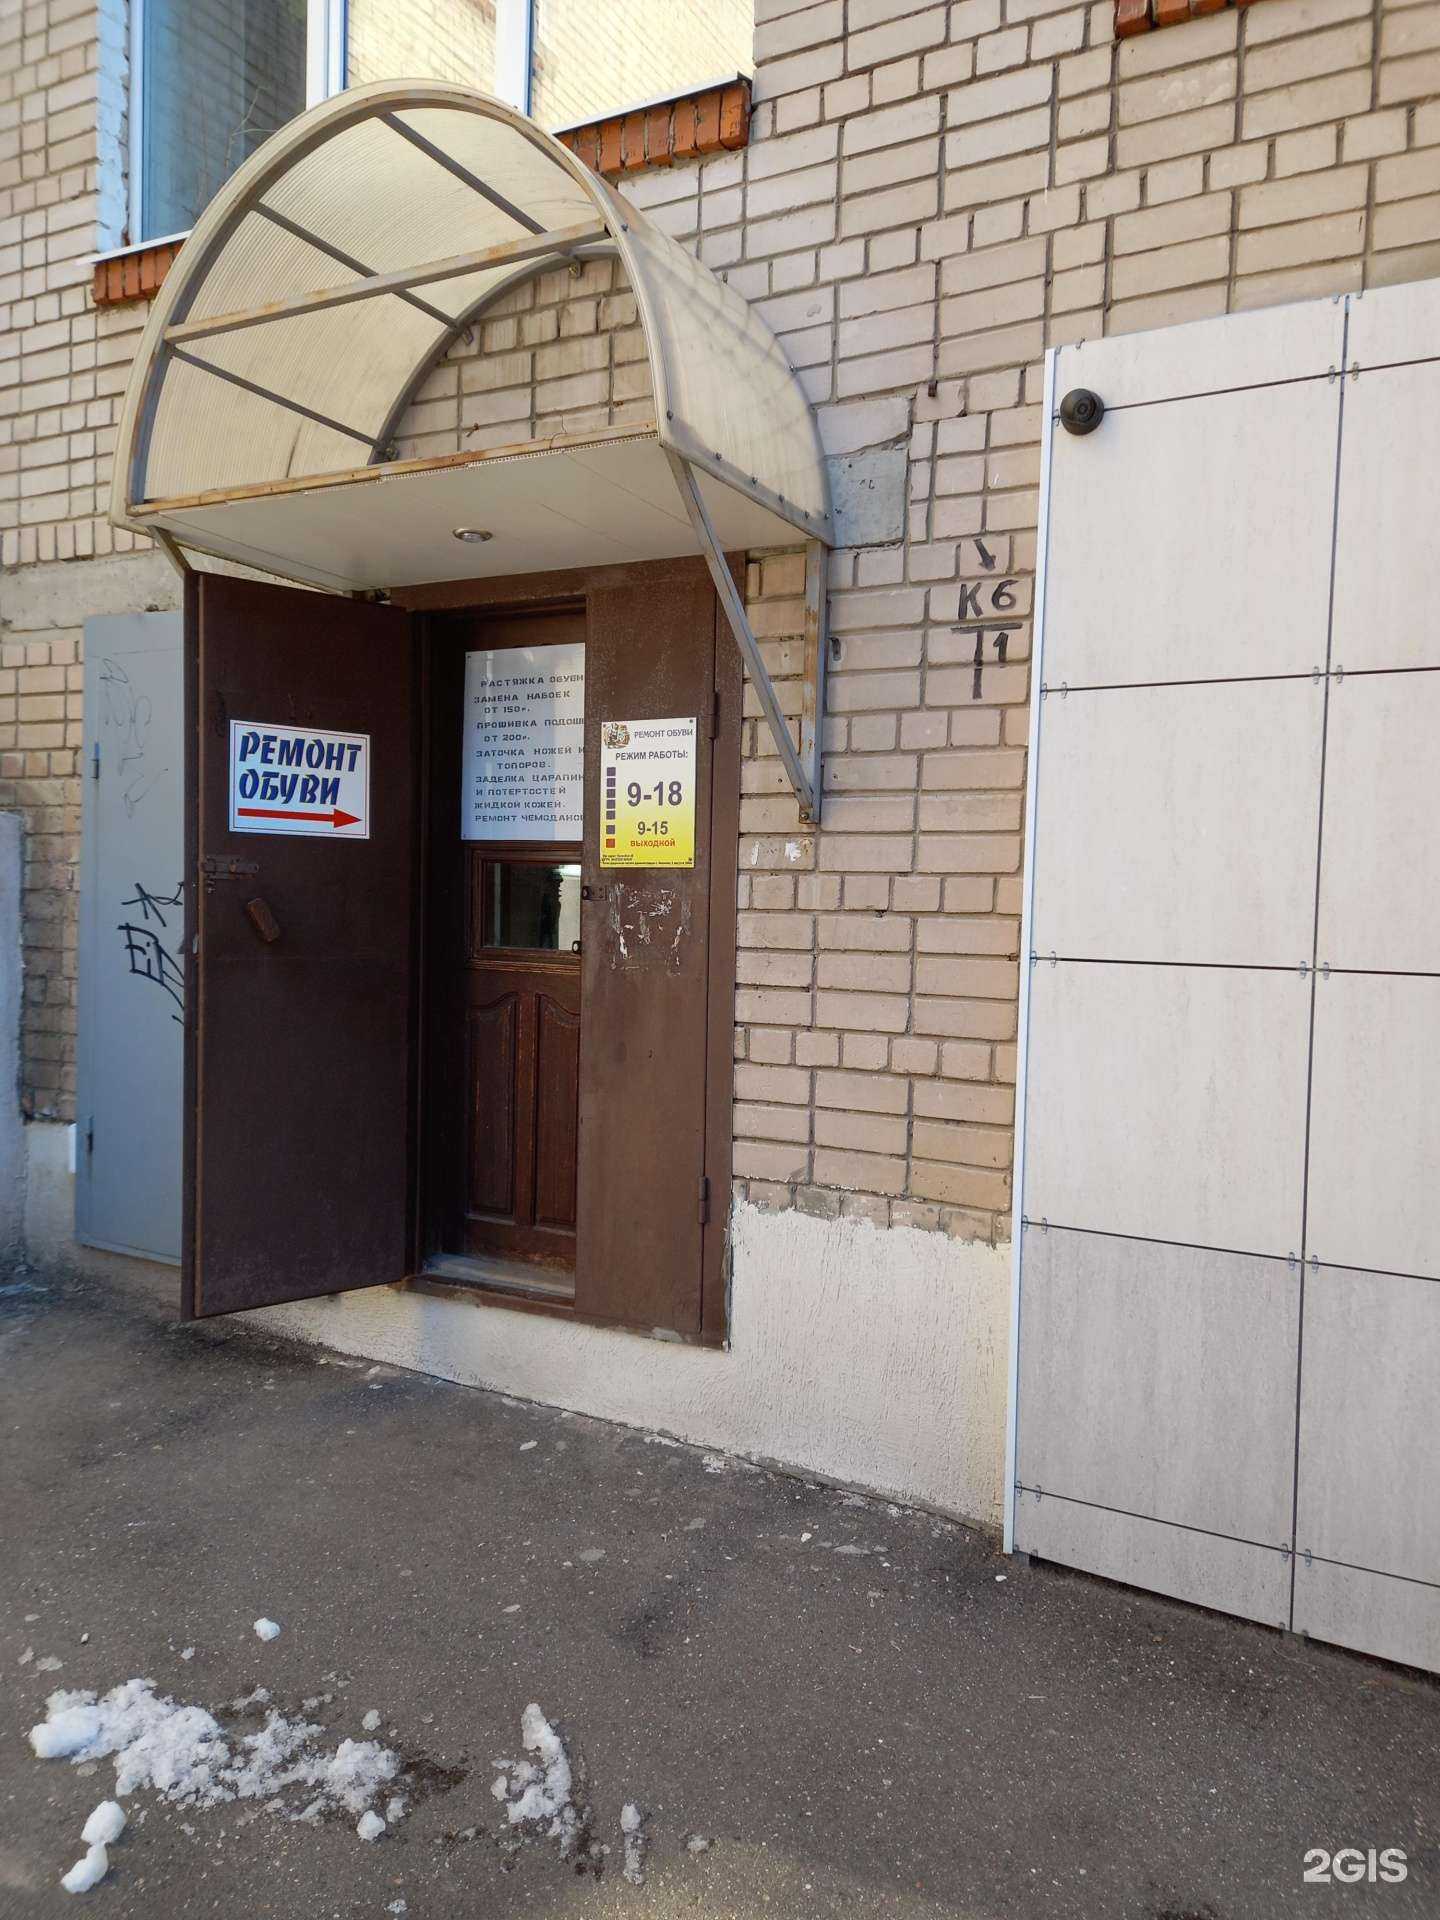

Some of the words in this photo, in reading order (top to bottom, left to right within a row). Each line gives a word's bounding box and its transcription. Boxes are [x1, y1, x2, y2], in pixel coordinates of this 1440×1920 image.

[480, 676, 544, 688] РАСТЯЖКА
[473, 694, 519, 704] ЗАМЕНА
[527, 690, 571, 700] НАБОЕК
[484, 706, 498, 714] ОТ
[476, 720, 537, 730] ПРОШИВКА
[634, 730, 665, 738] РЕМОНТ
[666, 728, 693, 737] ОБУВИ
[484, 735, 498, 743] ОТ
[239, 732, 362, 772] РЕМОНТ
[476, 748, 525, 758] ЗАТОЧКА
[534, 746, 572, 755] НОЖЕЙ
[616, 752, 646, 760] РЕЖИМ
[648, 750, 688, 760] РАБОТЫ:
[497, 761, 551, 770] ТОПОРОВ.
[476, 775, 525, 784] ЗАДЕЛКА
[239, 768, 340, 805] ОБУВИ
[627, 780, 682, 807] 9-18
[475, 814, 517, 822] РЕМОНТ
[638, 821, 668, 835] 9-15
